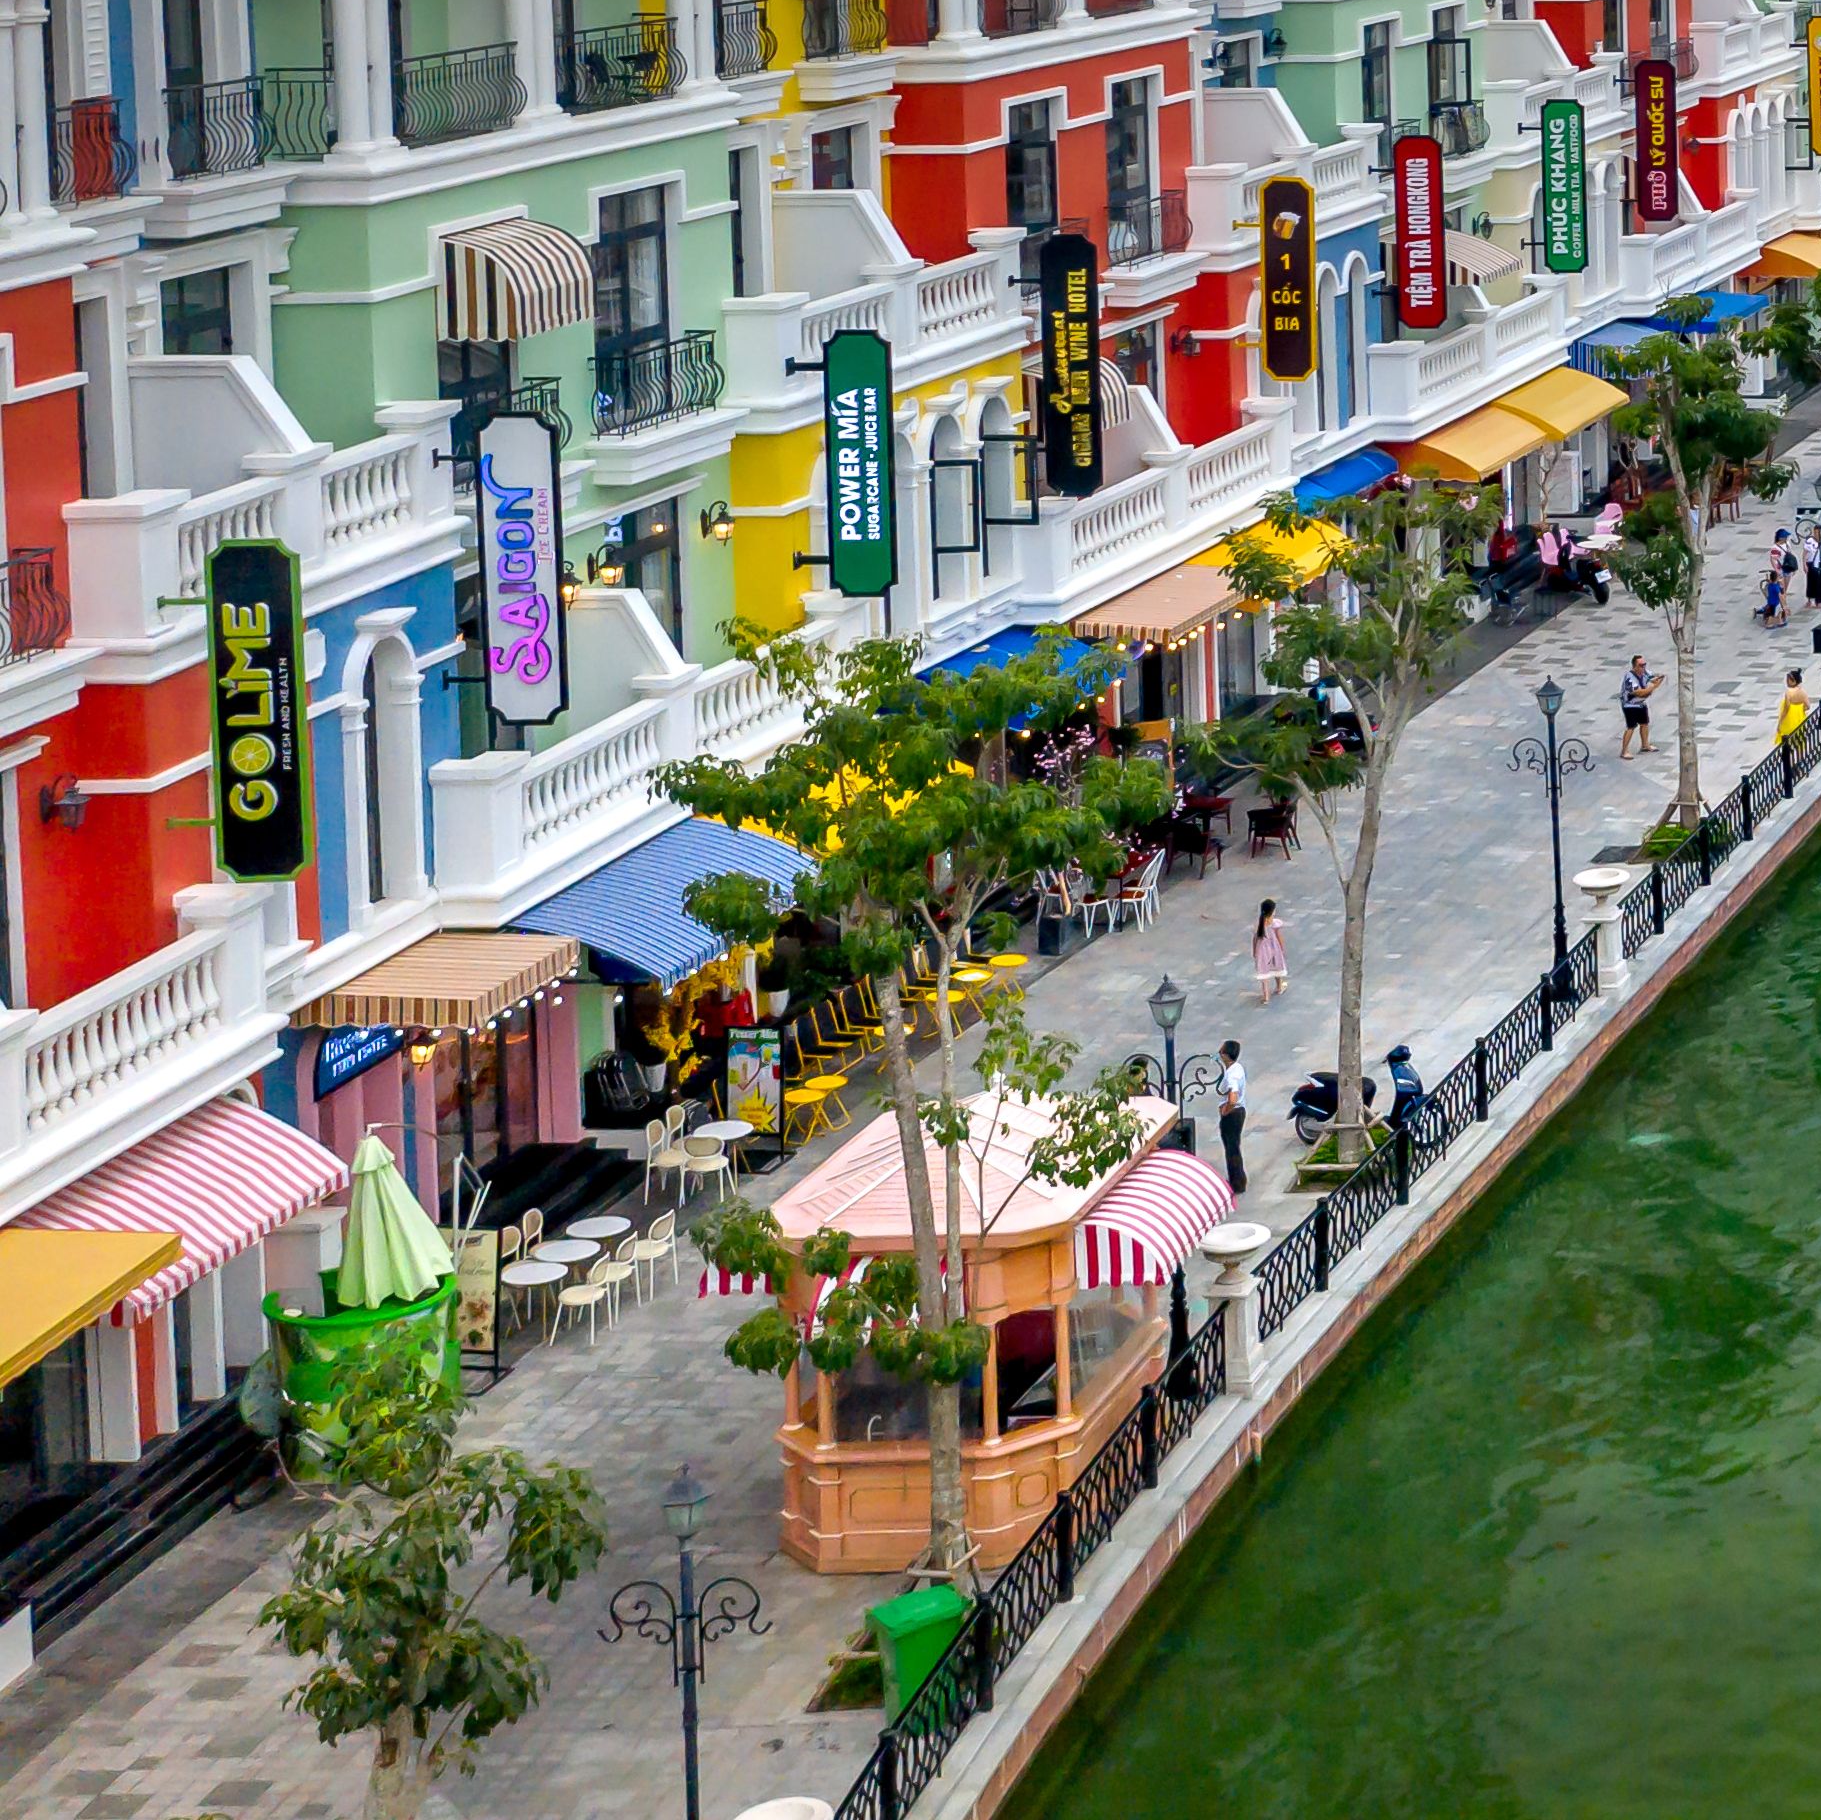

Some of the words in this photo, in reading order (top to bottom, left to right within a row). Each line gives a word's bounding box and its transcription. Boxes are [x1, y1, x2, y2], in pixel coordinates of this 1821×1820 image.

[1549, 118, 1567, 193] KHANG
[1405, 158, 1431, 235] HONGKONG
[1571, 191, 1580, 215] MILK
[1547, 197, 1569, 256] PHÚC
[1280, 253, 1291, 270] 1
[1405, 239, 1432, 268] TRÀ
[1067, 268, 1087, 313] HOTEL
[1405, 272, 1437, 307] TIỆM
[1069, 322, 1088, 362] WINE
[1274, 316, 1300, 331] BIA
[863, 387, 877, 412] BAR
[864, 414, 878, 451] JUICE
[537, 488, 549, 535] CREAM
[839, 447, 863, 541] POWER
[865, 461, 880, 541] SUGARCANE
[481, 453, 551, 686] SAIGON
[538, 541, 556, 565] ICE
[279, 657, 289, 703] HEALTH
[281, 705, 291, 730] AND
[282, 732, 293, 771] FRESH
